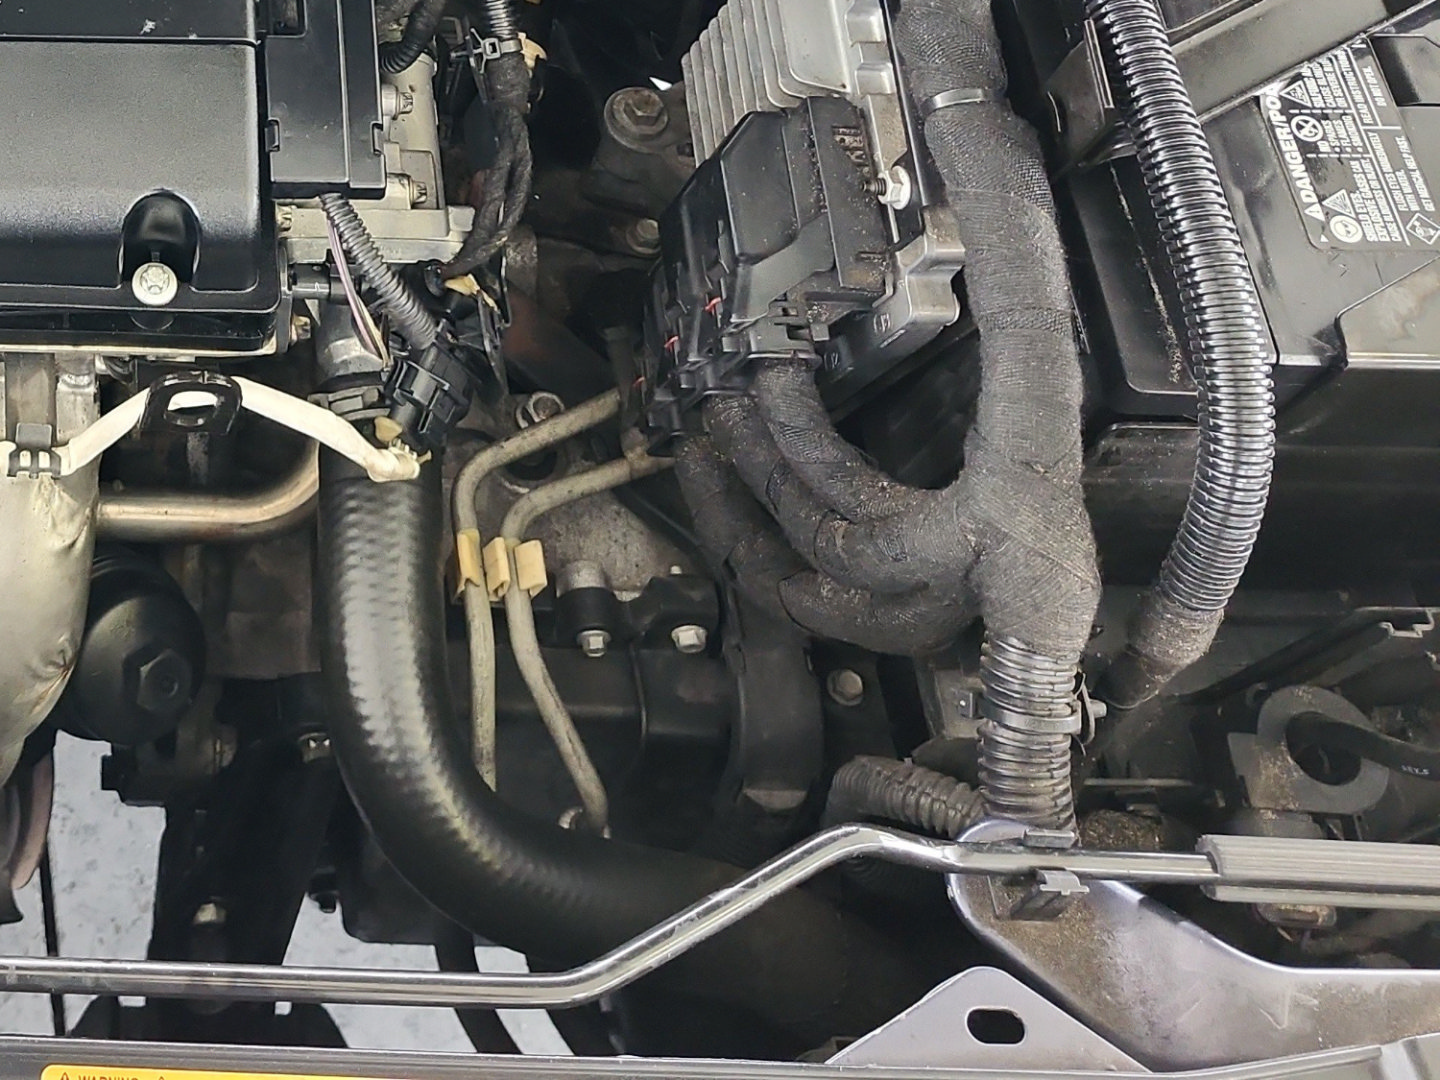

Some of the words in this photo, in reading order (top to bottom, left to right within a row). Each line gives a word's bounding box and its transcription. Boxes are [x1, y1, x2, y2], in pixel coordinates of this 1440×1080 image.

[1317, 140, 1330, 152] NO
[1320, 118, 1340, 146] SPARKS
[1331, 118, 1351, 146] FLAMES
